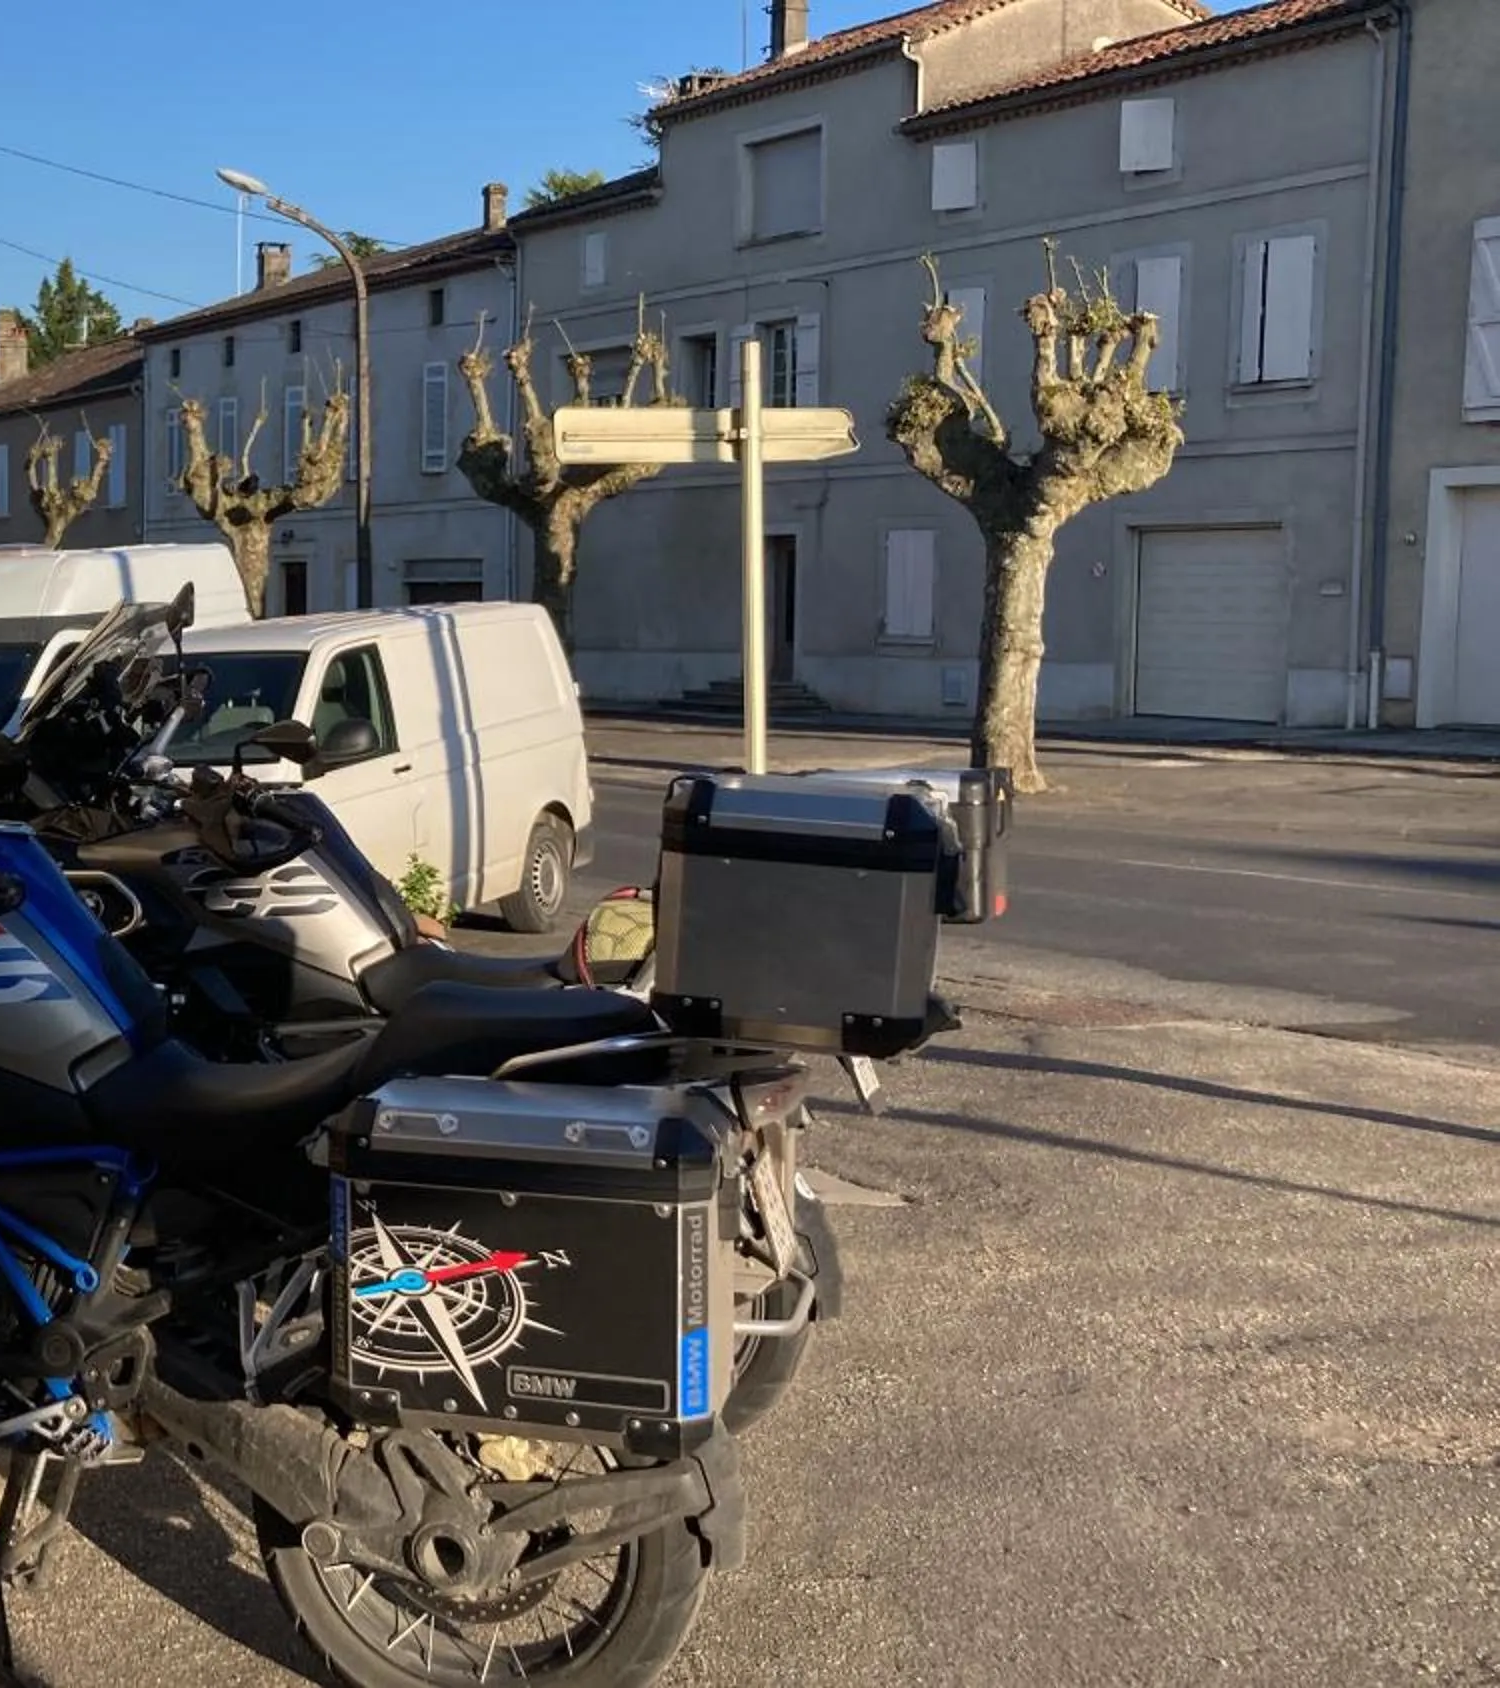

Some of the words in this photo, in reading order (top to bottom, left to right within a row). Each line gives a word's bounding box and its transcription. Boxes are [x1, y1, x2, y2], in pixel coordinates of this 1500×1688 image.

[537, 1248, 572, 1269] N
[687, 1213, 704, 1326] Motorrad
[512, 1372, 577, 1399] BMW
[687, 1337, 703, 1408] BMW
